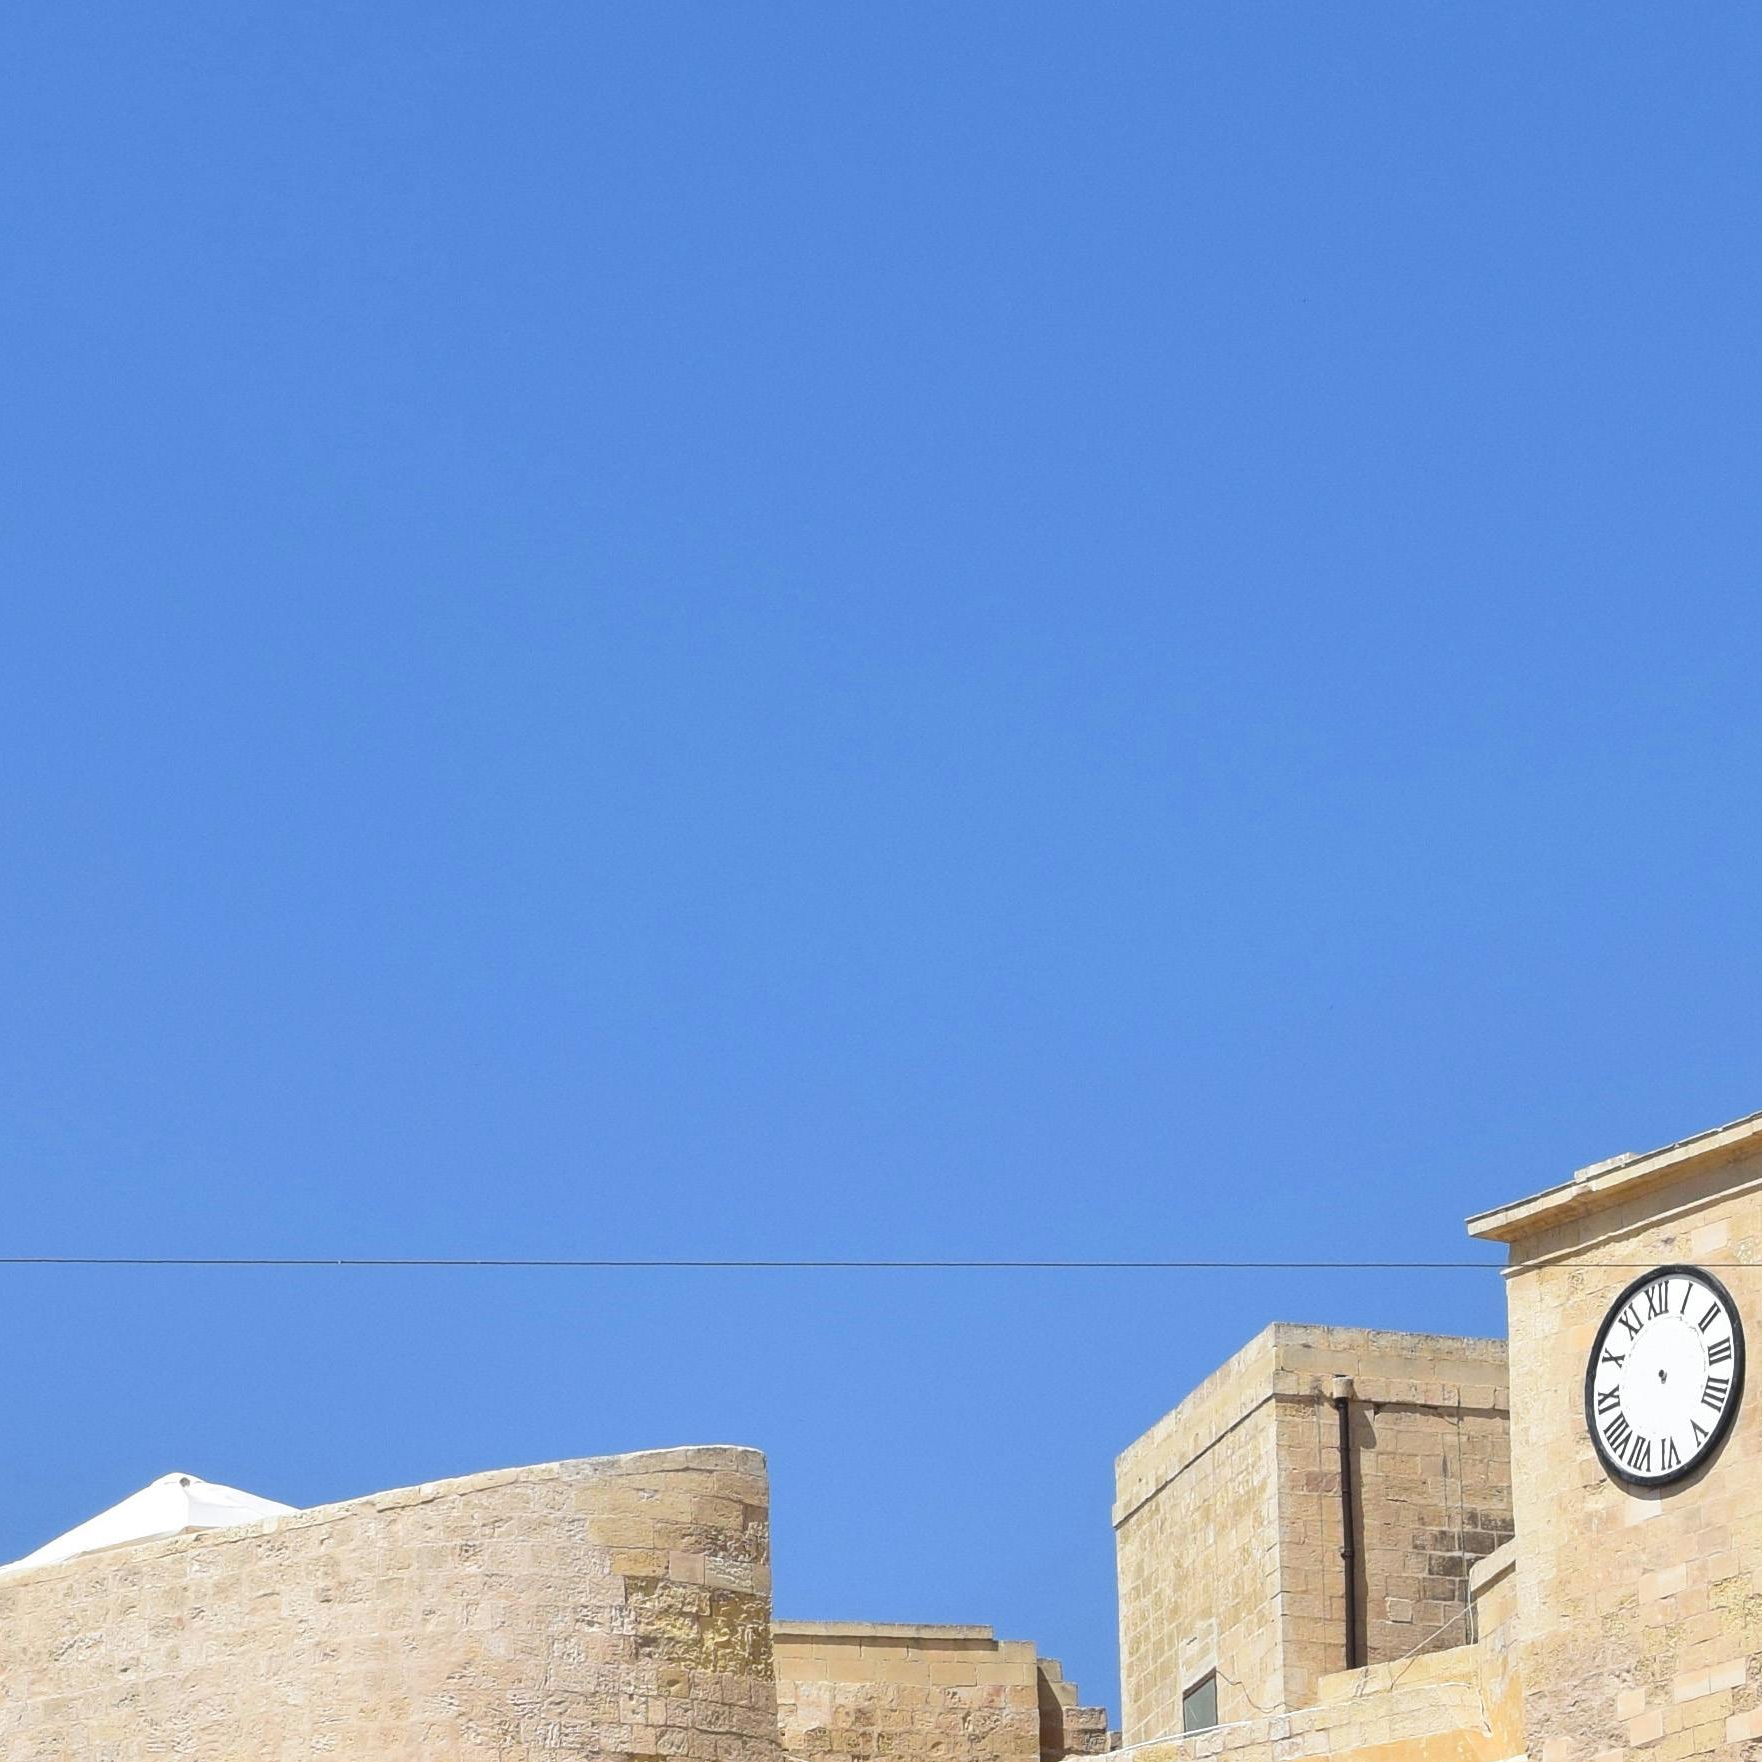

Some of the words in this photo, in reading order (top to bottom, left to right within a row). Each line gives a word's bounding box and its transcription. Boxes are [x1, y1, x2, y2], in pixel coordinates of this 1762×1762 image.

[1644, 1280, 1669, 1320] XII
[1680, 1282, 1693, 1315] I
[1618, 1302, 1644, 1341] XI
[1697, 1301, 1721, 1332] II
[1601, 1347, 1625, 1369] X
[1706, 1336, 1732, 1366] III
[1597, 1384, 1621, 1416] IX
[1701, 1376, 1729, 1413] IIII
[1603, 1412, 1633, 1461] VIII
[1690, 1419, 1709, 1448] V
[1627, 1435, 1652, 1473] VII
[1660, 1436, 1682, 1471] VI
